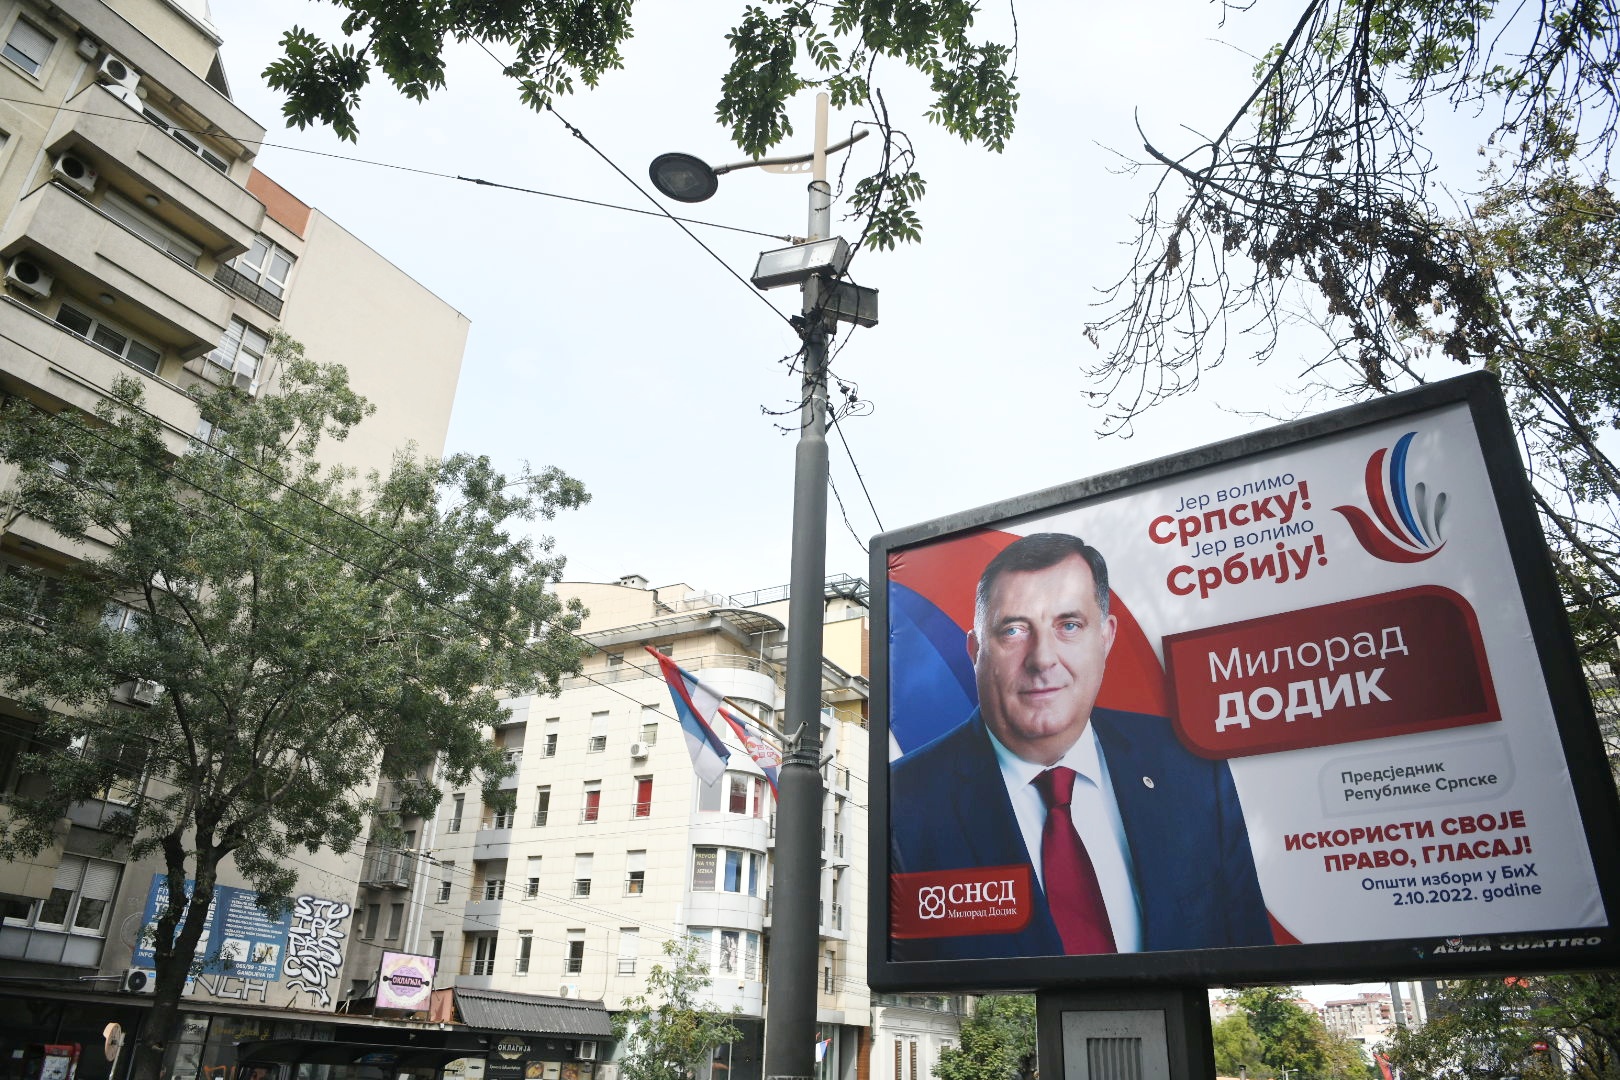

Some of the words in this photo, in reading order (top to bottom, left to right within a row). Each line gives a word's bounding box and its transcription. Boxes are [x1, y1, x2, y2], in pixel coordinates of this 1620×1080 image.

[1175, 494, 1210, 512] Јер
[1216, 473, 1295, 502] волимо
[1148, 480, 1312, 547] Српску!
[1191, 539, 1227, 559] Јер
[1233, 520, 1314, 549] волимо
[1166, 534, 1328, 599] Србију!
[1208, 626, 1409, 683] Милорад
[1215, 667, 1393, 733] ДОДИК
[1341, 762, 1446, 786] Предсједник
[1344, 782, 1431, 801] Републике
[1435, 774, 1498, 793] Српске
[1284, 820, 1435, 852] ИСКОРИСТИ
[1440, 810, 1527, 836] СВОЈЕ
[1323, 848, 1417, 873] ПРАВО,
[1421, 835, 1533, 864] ГЛАСАЈ!
[948, 879, 1016, 906] СНСД
[1361, 876, 1417, 891] Општи
[1421, 870, 1484, 888] избори
[1486, 868, 1497, 882] у
[1501, 863, 1539, 880] БиХ
[1392, 887, 1478, 906] 2.10.2022.
[1482, 882, 1542, 903] godine
[947, 908, 988, 919] Милорад
[988, 906, 1017, 918] Додик
[1499, 936, 1602, 951] QUATTRO
[497, 1044, 531, 1053] ОКЛАГИЈА
